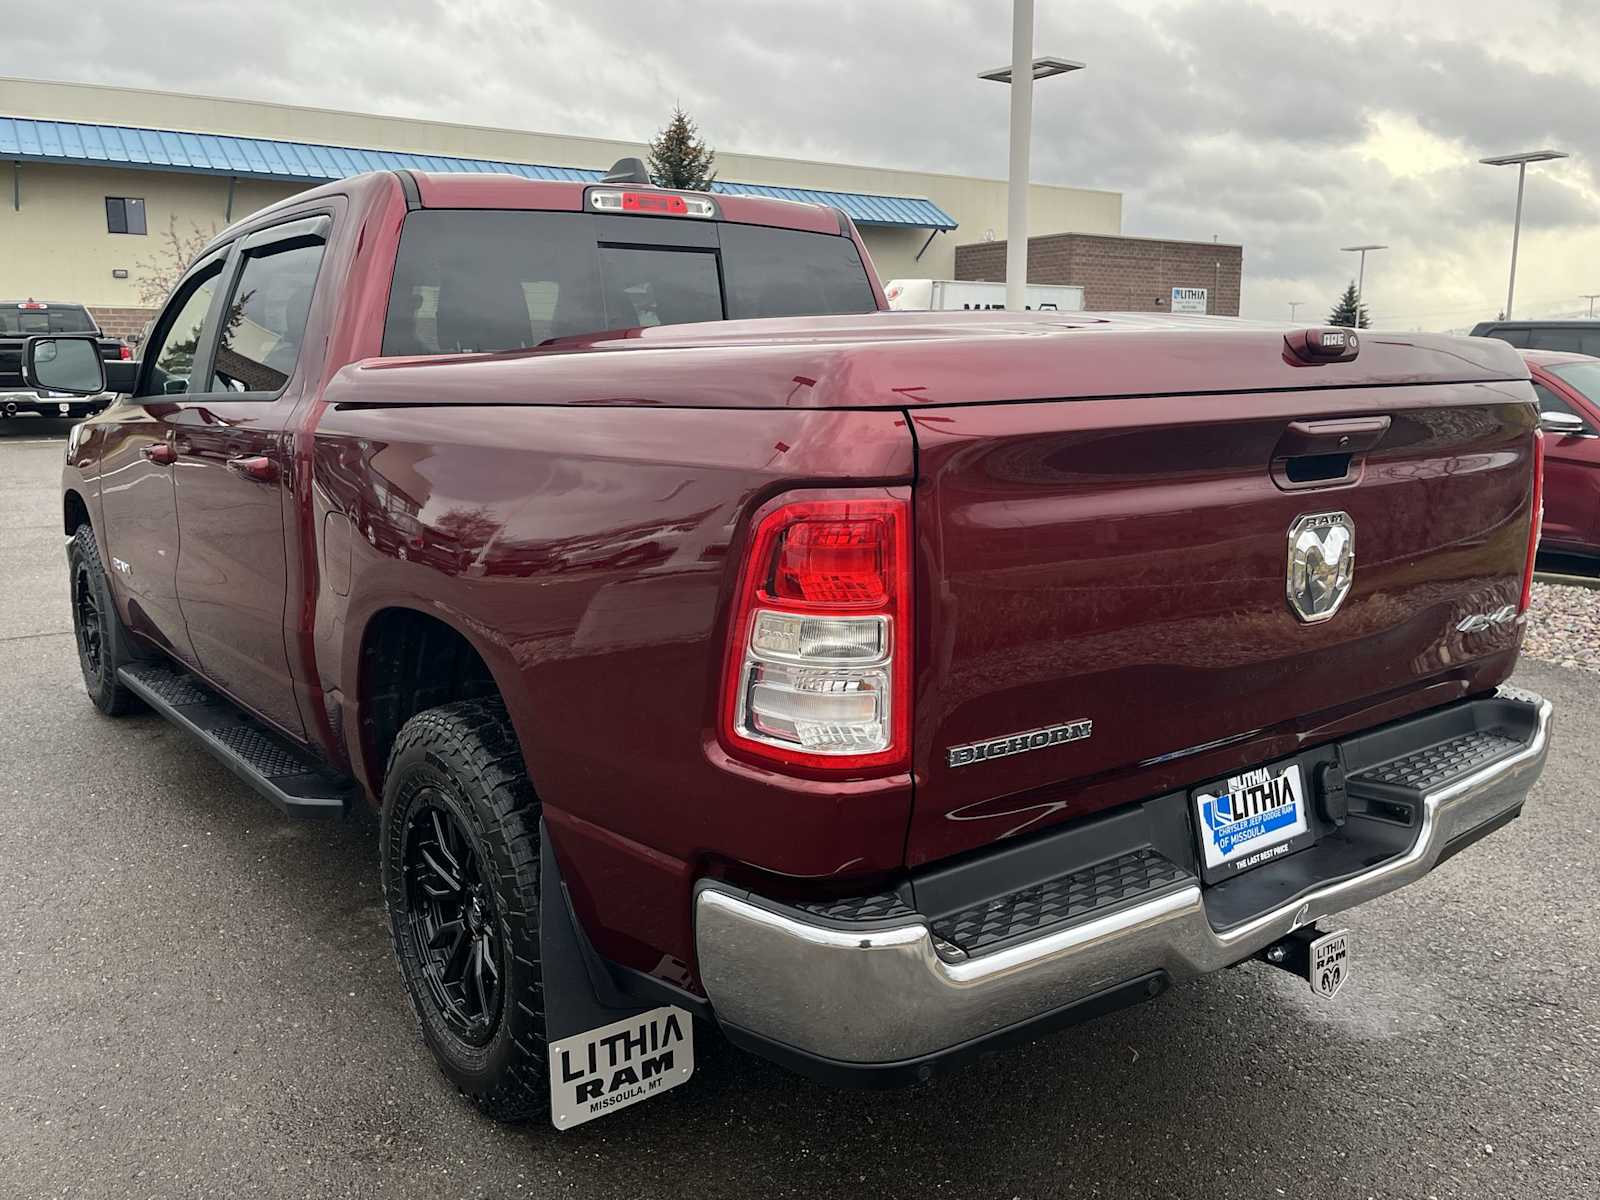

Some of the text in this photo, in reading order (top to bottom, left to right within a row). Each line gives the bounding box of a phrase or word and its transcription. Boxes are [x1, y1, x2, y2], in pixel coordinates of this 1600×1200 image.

[1180, 289, 1205, 300] LITHIA
[1306, 514, 1343, 526] RAM
[947, 719, 1093, 768] BIGHORN
[1237, 767, 1271, 788] LITHIA
[1232, 776, 1295, 821] LITHIA
[1249, 815, 1263, 827] JEEP
[1262, 810, 1282, 822] DODGE
[1281, 804, 1293, 815] RAM
[1219, 824, 1266, 849] OF MISSOULA
[1235, 843, 1289, 869] THE LAST BEST PRICE
[1317, 938, 1345, 959] LITHIA
[1317, 949, 1346, 970] RAM
[561, 1013, 683, 1083] LITHIA
[575, 1050, 674, 1105] RAM
[649, 1077, 663, 1090] MT
